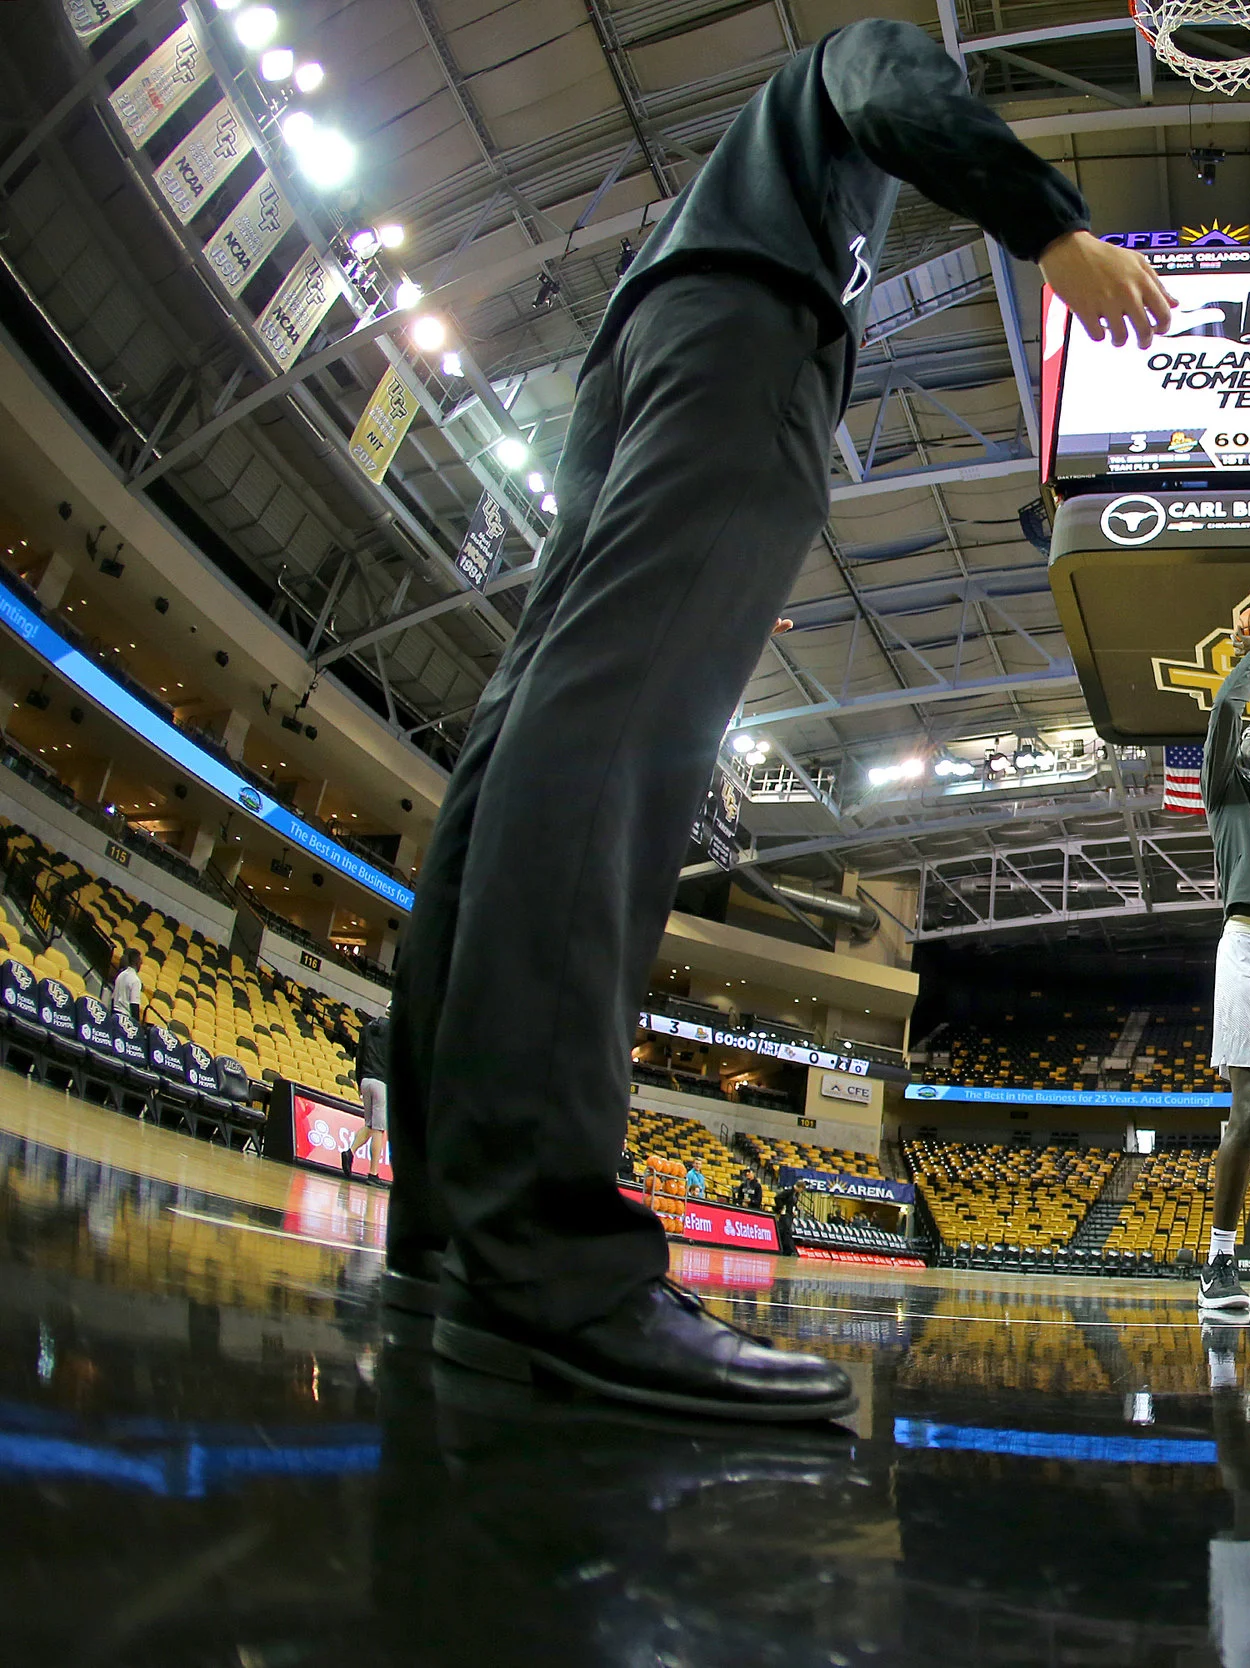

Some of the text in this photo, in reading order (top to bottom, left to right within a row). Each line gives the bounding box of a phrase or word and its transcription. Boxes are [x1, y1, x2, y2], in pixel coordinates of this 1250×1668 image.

[173, 34, 198, 83] UCF
[213, 109, 237, 158] UCF
[175, 156, 203, 198] NCAA
[160, 169, 192, 213] 2009
[258, 182, 280, 232] UCF
[224, 231, 251, 271] NCAA
[1098, 230, 1178, 248] CFE
[210, 246, 240, 286] 1999
[1153, 252, 1194, 264] BLACK
[1195, 252, 1250, 262] ORLANDO
[304, 256, 326, 305] UCF
[273, 306, 300, 345] NCAA
[386, 376, 408, 420] UCF
[366, 431, 384, 451] NIT
[1128, 433, 1147, 453] 3
[353, 444, 378, 472] 2017
[1221, 454, 1245, 465] 1ST
[1057, 473, 1096, 481] DAKTRONICS
[483, 493, 504, 539] UCF
[1168, 501, 1228, 519] CARL
[459, 556, 483, 585] 1994
[0, 597, 39, 638] nting!
[110, 846, 127, 863] 115
[290, 821, 307, 839] The
[308, 834, 329, 857] Best
[330, 848, 340, 863] in
[341, 855, 358, 873] the
[359, 866, 395, 897] Business
[396, 889, 409, 905] for
[303, 954, 318, 969] 116
[10, 960, 32, 990] UCF
[46, 979, 69, 1008] UCF
[85, 996, 107, 1024] UCF
[117, 1013, 138, 1039] UCF
[157, 1027, 178, 1051] UCF
[669, 1021, 679, 1034] 3
[714, 1031, 757, 1051] 60:00
[190, 1044, 210, 1070] UCF
[809, 1052, 819, 1064] 0
[848, 1086, 869, 1098] CFE
[964, 1090, 1214, 1106] The Best in the Business for 25 Years. And Counting!
[800, 1119, 814, 1128] 101
[847, 1184, 894, 1199] ARENA
